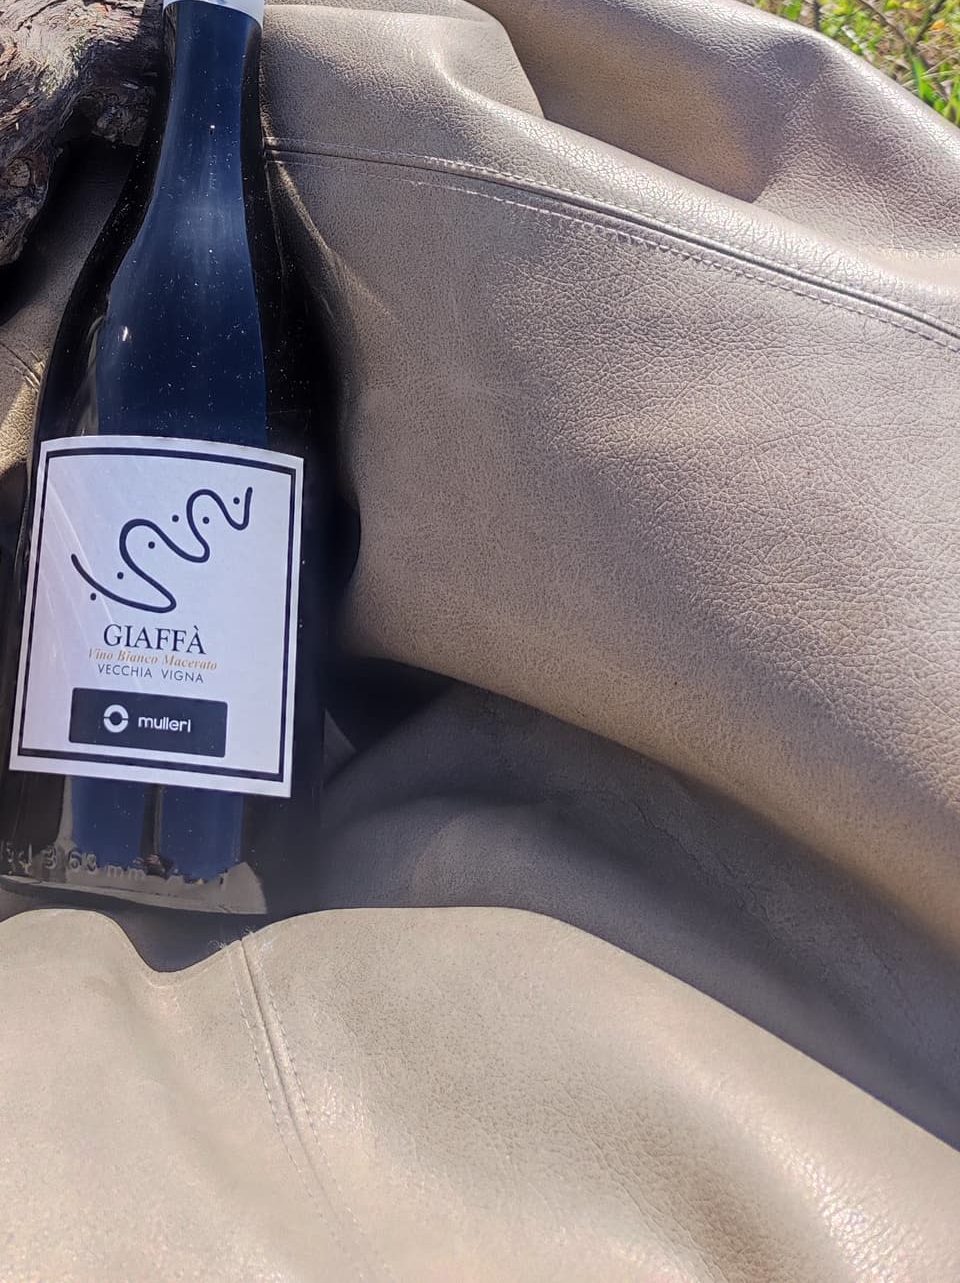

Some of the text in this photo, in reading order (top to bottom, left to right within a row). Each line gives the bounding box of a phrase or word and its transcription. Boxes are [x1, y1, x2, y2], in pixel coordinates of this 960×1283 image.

[103, 623, 207, 655] GIAFFÀ
[89, 647, 218, 670] Vino Bianco Macerato
[97, 663, 204, 684] VECCHIA VIGNA
[138, 716, 192, 734] mulleri
